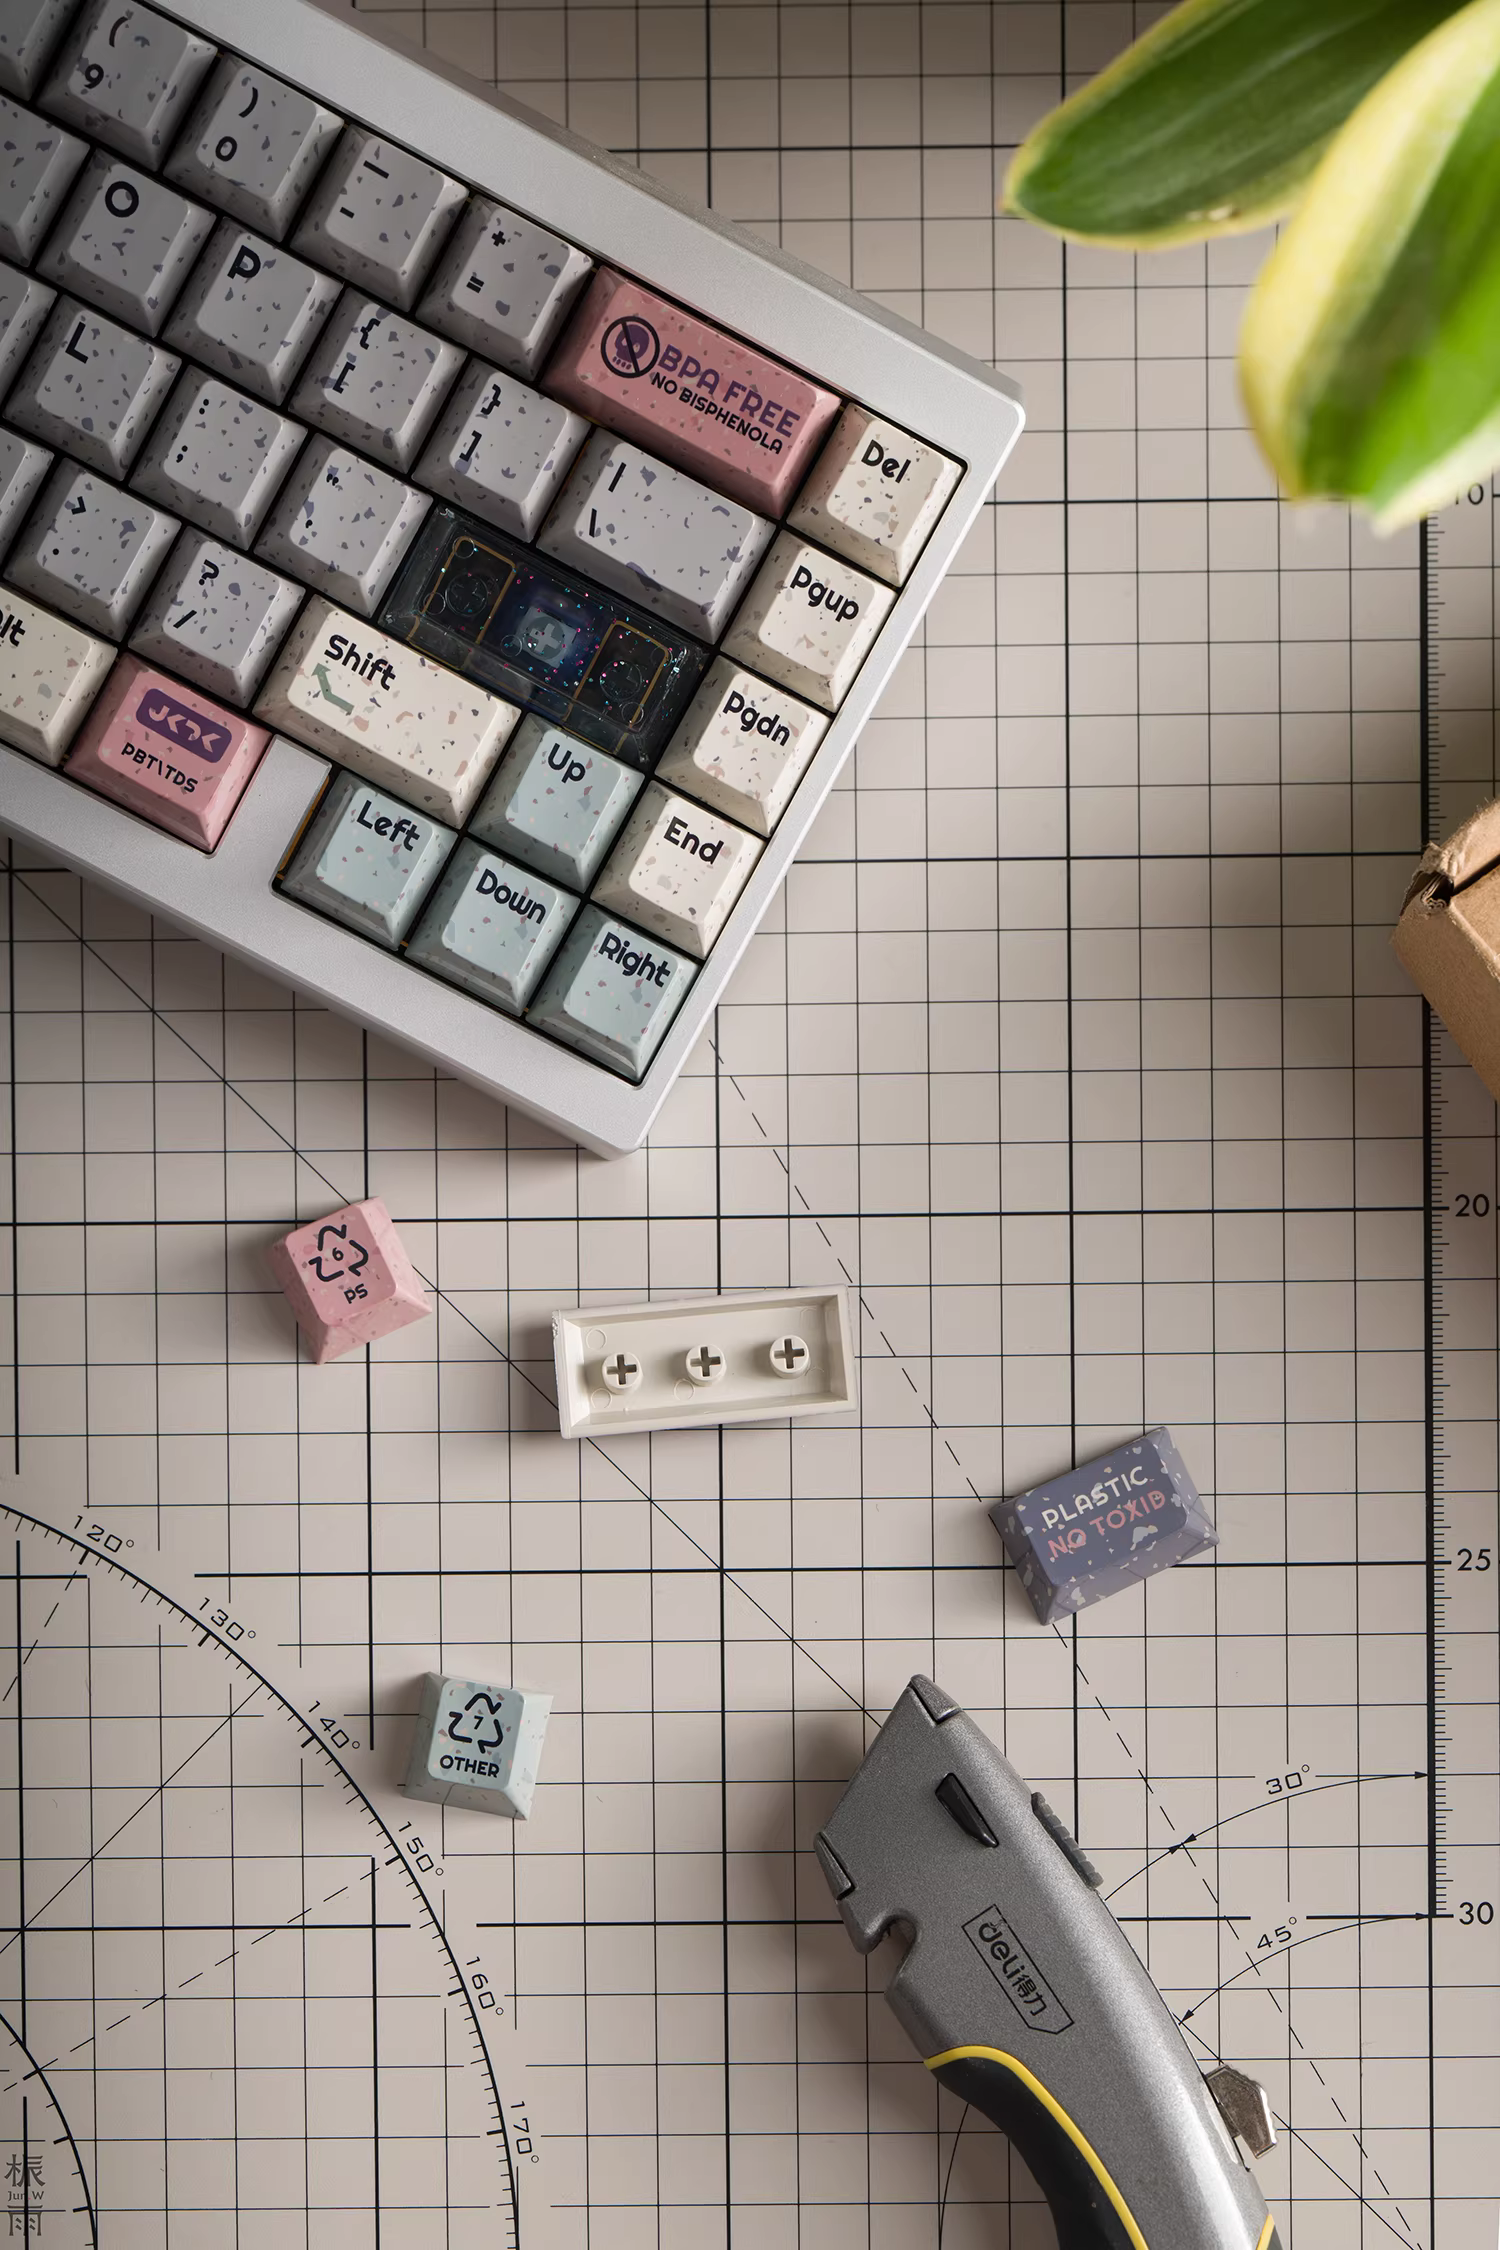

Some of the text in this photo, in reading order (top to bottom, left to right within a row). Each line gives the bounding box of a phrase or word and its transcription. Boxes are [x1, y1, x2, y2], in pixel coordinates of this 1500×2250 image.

[84, 63, 105, 90] 9
[104, 180, 140, 218] O
[227, 244, 262, 280] P
[65, 321, 89, 364] L
[651, 372, 784, 455] NO BISPHENOLA
[658, 344, 801, 438] BPA FREE
[861, 439, 911, 484] Del
[789, 565, 860, 623] Pgup
[0, 609, 26, 648] lt
[324, 634, 397, 692] Shift
[722, 690, 791, 747] Pgdn
[547, 742, 586, 784] Up
[356, 799, 421, 852] Left
[663, 815, 725, 865] End
[475, 868, 547, 925] Down
[598, 931, 671, 988] Right
[1455, 1193, 1490, 1218] 20
[332, 1246, 344, 1262] 6
[343, 1282, 369, 1305] PS
[1041, 1466, 1149, 1529] PLASTIC
[73, 1514, 135, 1553] 120°
[1047, 1489, 1166, 1558] NO TOXID
[1457, 1547, 1491, 1572] 25
[198, 1596, 257, 1641] 130°
[307, 1699, 361, 1749] 140°
[473, 1715, 485, 1730] 7
[439, 1754, 500, 1778] OTHER
[1265, 1763, 1311, 1795] 30°
[398, 1820, 445, 1877] 150°
[1256, 1915, 1298, 1950] 45°
[1459, 1901, 1494, 1926] 30
[465, 1955, 505, 2016] 160°
[509, 2100, 540, 2164] 170°
